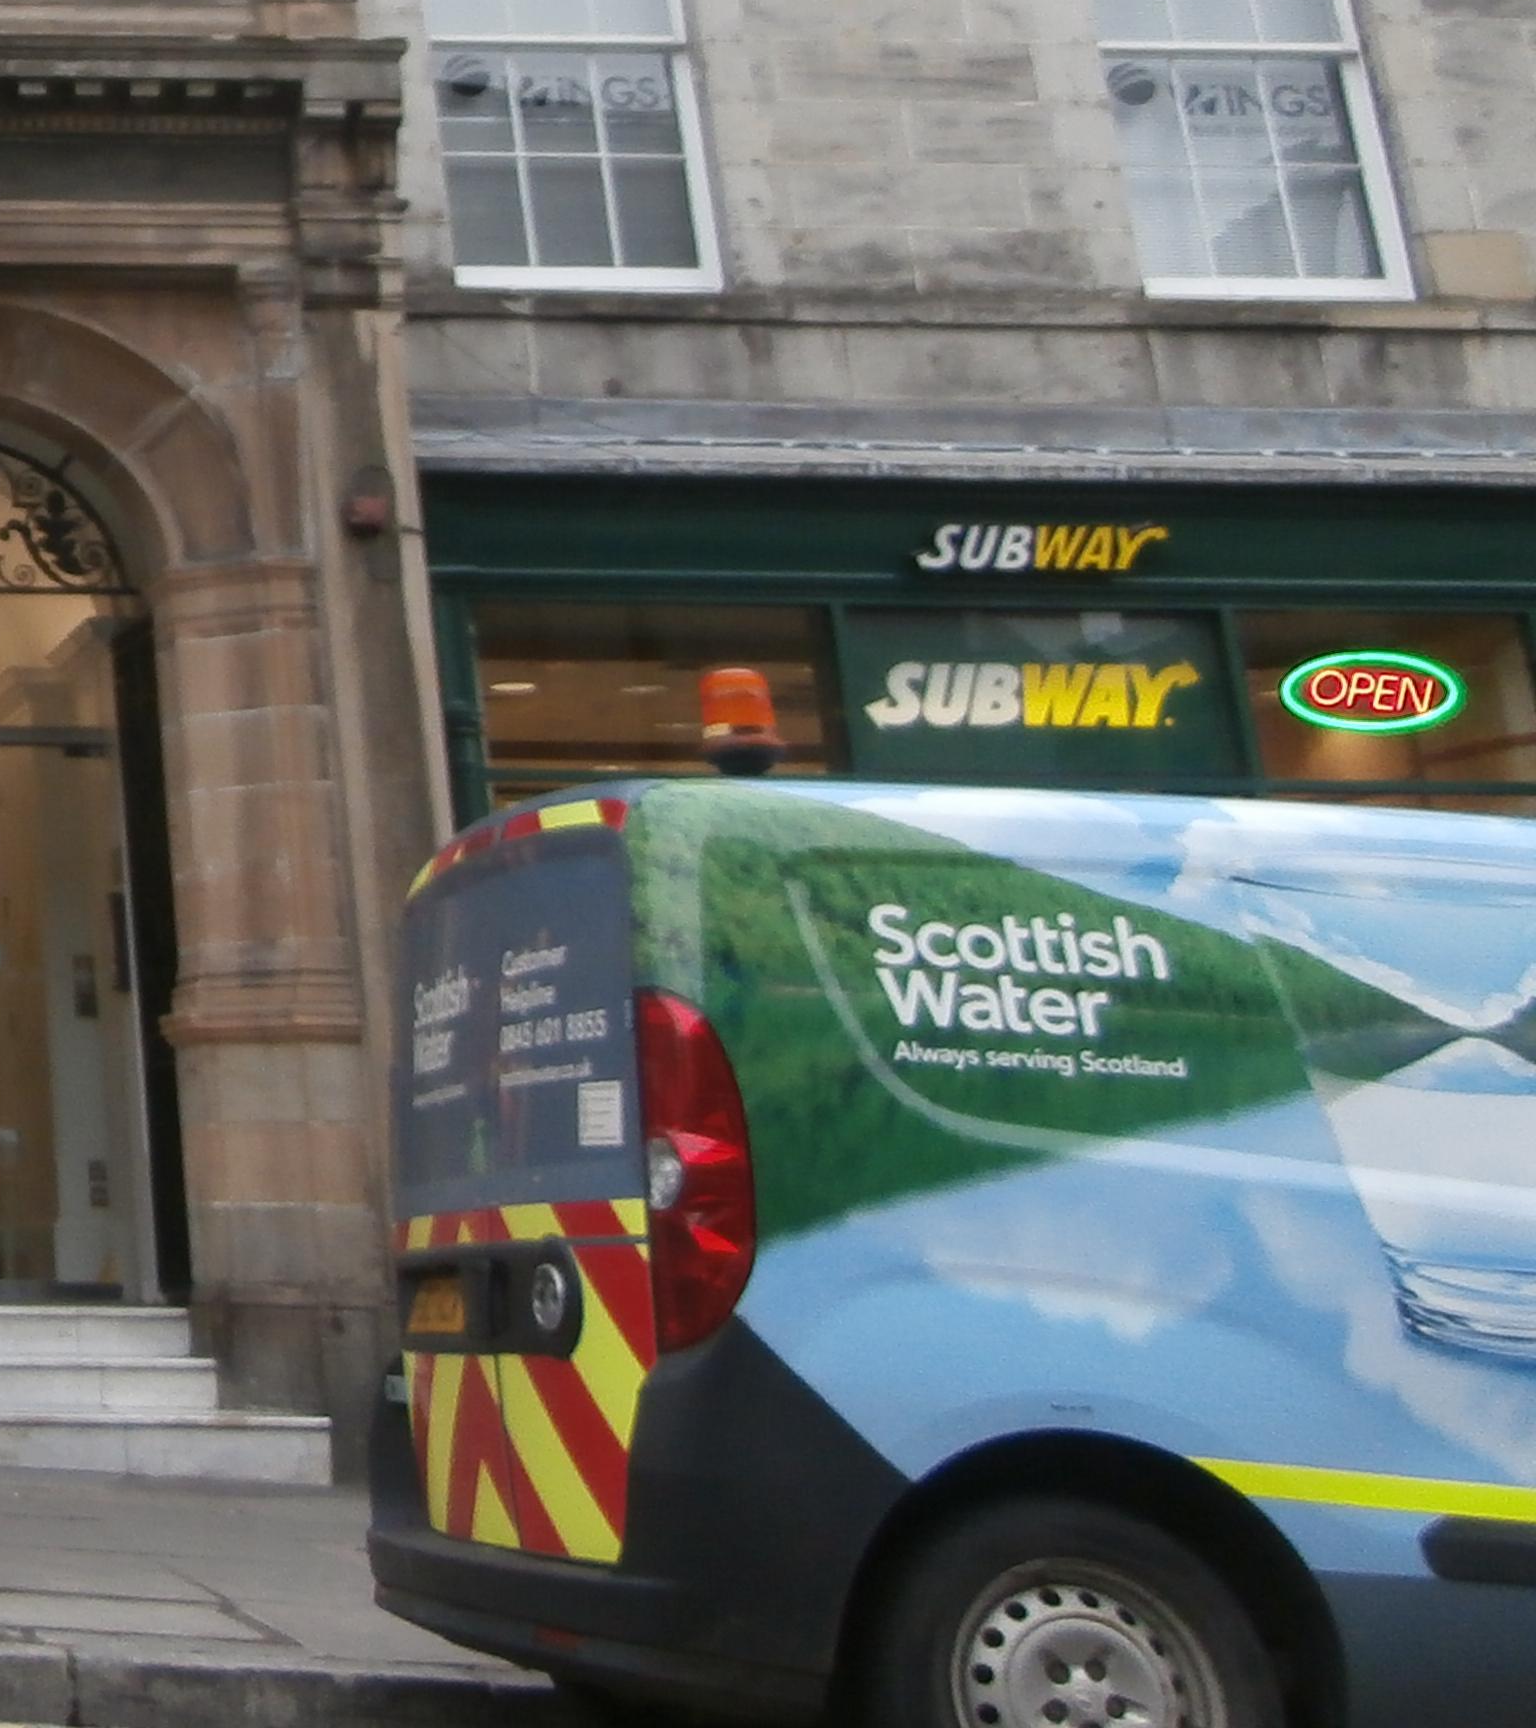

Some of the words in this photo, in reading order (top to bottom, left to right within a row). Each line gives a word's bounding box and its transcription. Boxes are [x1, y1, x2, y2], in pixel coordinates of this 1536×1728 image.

[914, 523, 1170, 571] SUBWAY
[863, 660, 1200, 729] SUBWAY
[1310, 669, 1434, 713] OPEN
[867, 903, 1170, 981] Scottish
[875, 967, 1110, 1037] Water
[893, 1038, 980, 1070] Always
[985, 1045, 1076, 1077] serving
[1080, 1050, 1188, 1079] Scotland
